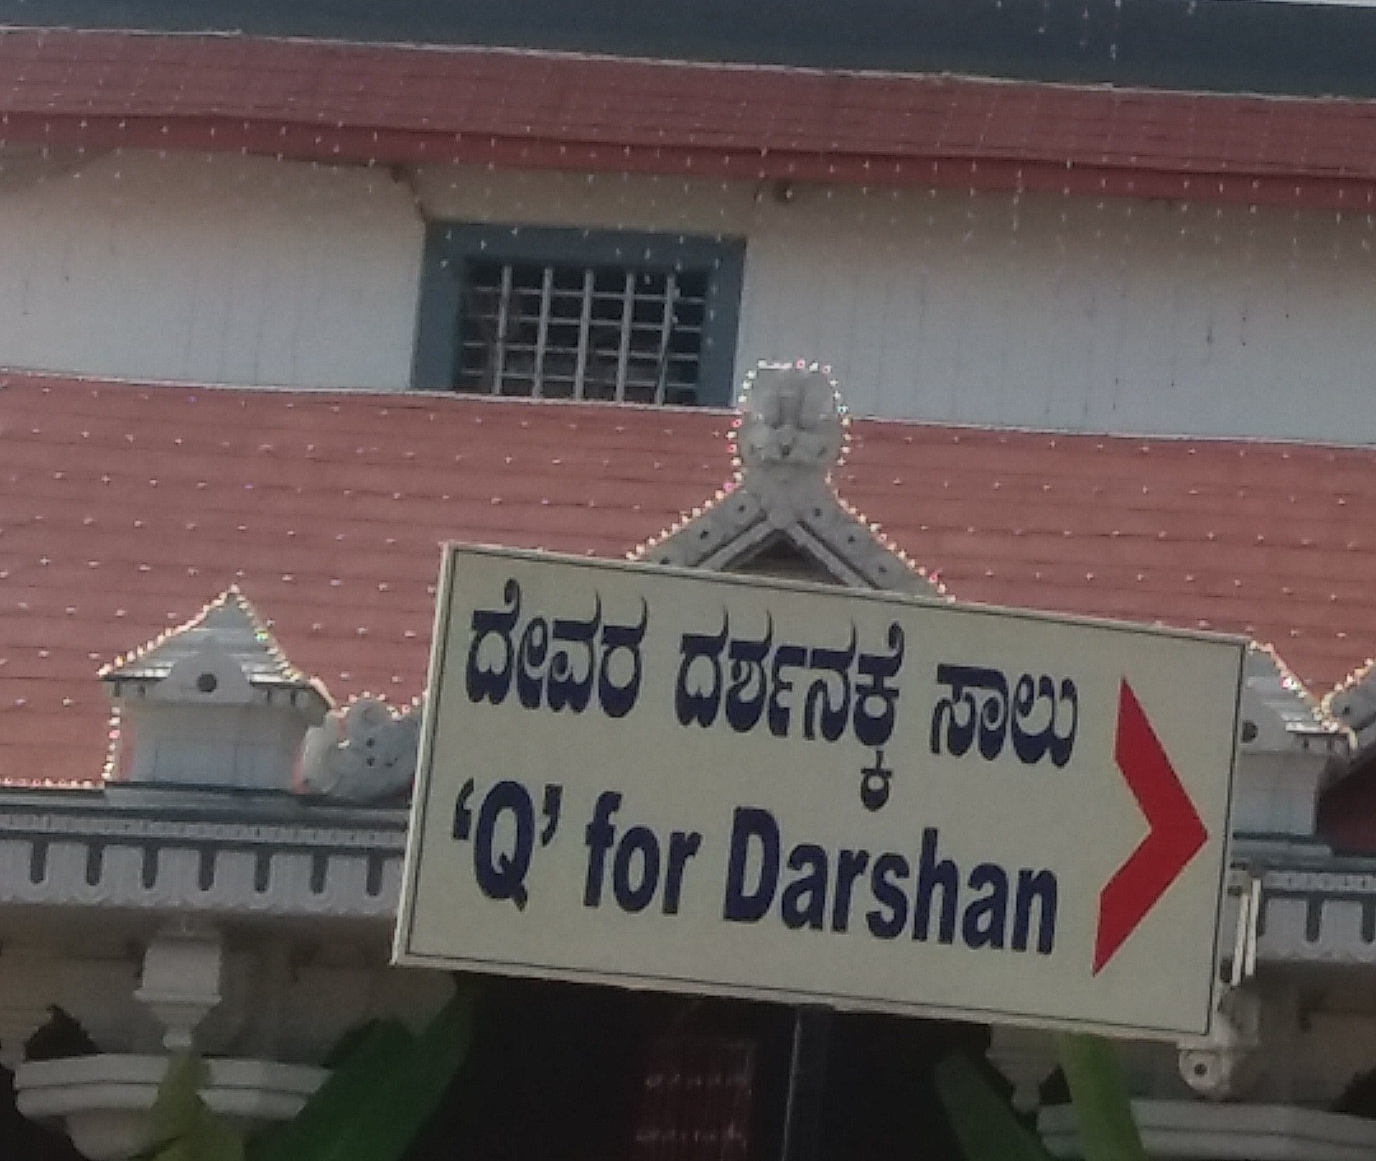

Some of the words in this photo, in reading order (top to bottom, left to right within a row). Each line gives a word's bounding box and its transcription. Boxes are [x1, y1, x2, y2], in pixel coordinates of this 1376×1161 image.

[466, 578, 648, 719] ದೇವರ
[674, 609, 905, 813] ದರ್ಶನಕ್ಕೆ
[929, 663, 1078, 770] ಸಾಲು
[582, 790, 703, 917] for
[722, 805, 1058, 956] Darshan
